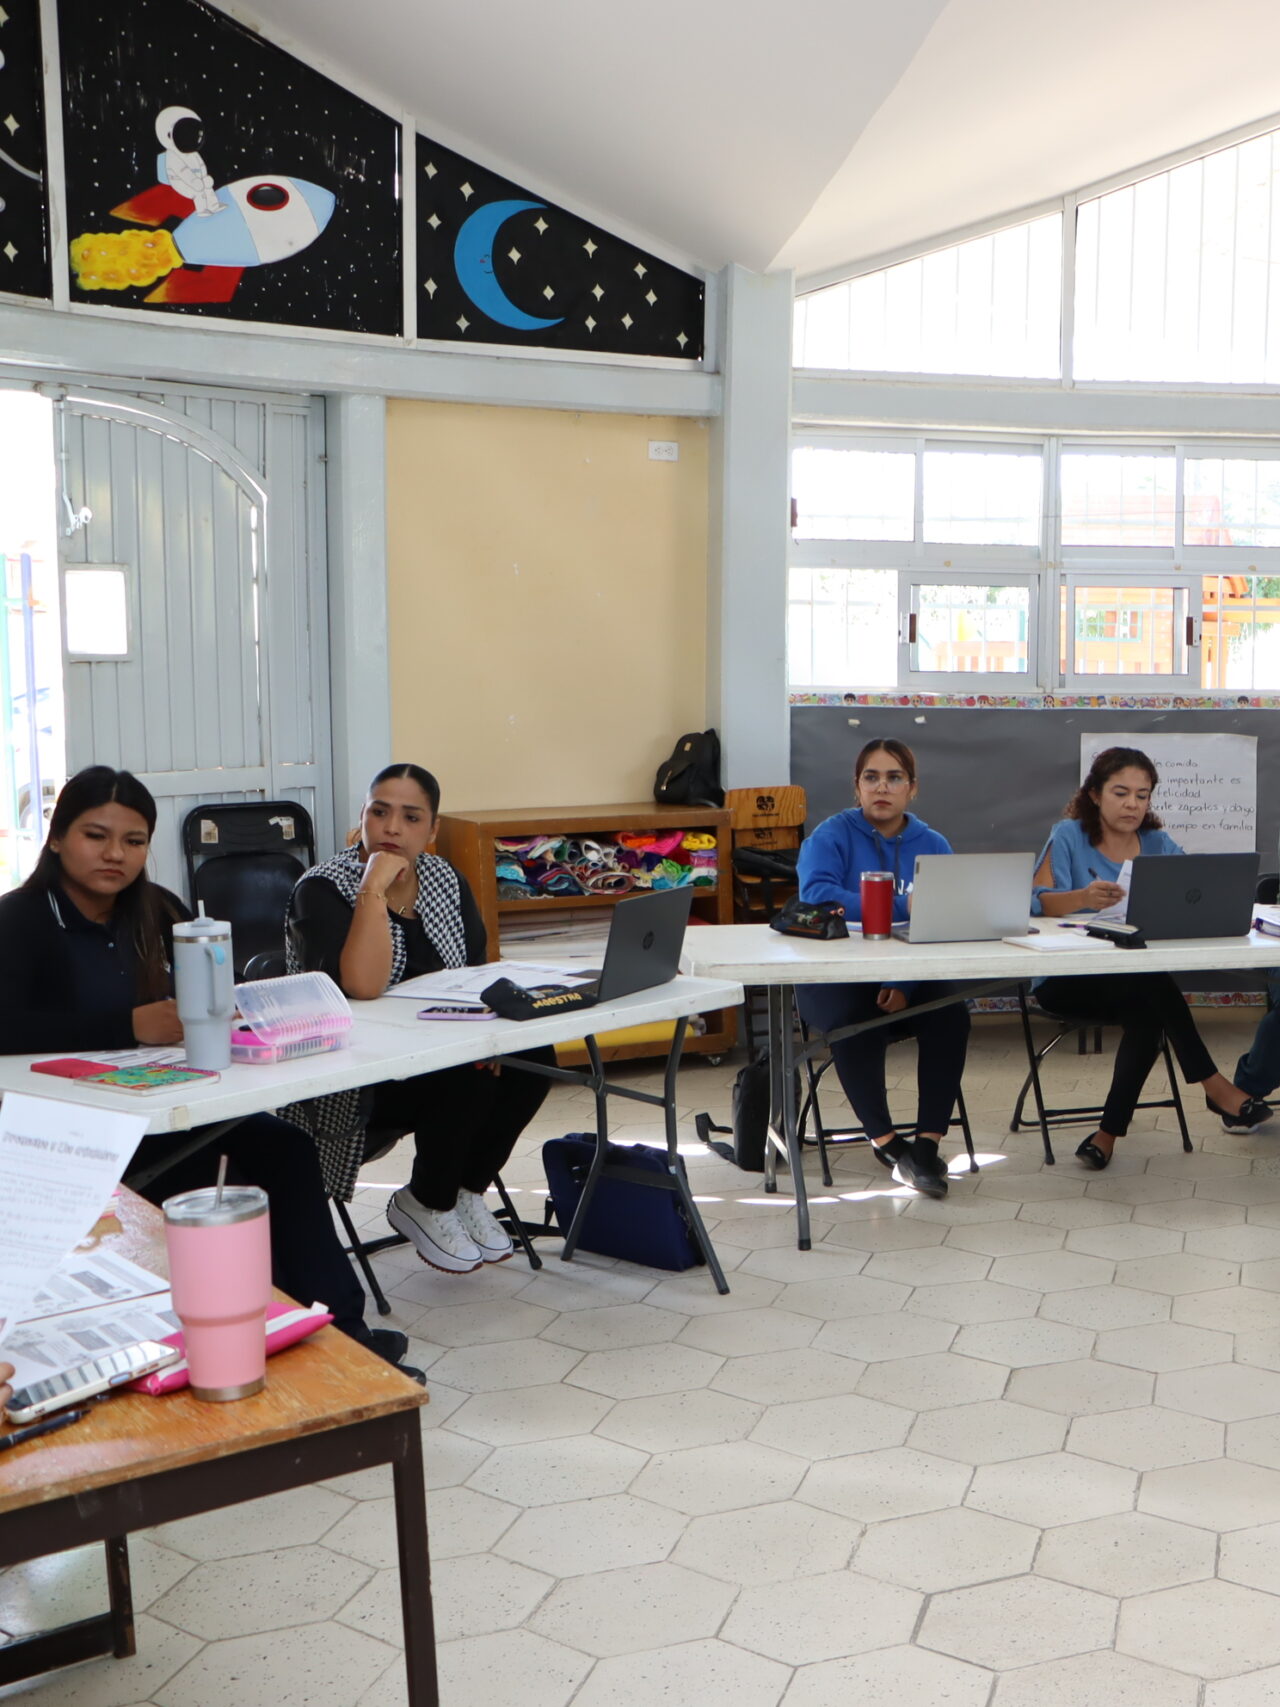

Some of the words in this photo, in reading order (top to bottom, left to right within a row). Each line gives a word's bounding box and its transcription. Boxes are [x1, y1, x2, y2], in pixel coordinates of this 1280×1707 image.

[1167, 772, 1224, 787] importante
[1230, 777, 1241, 785] es
[1157, 785, 1201, 798] felicidad
[1219, 818, 1253, 831] familia
